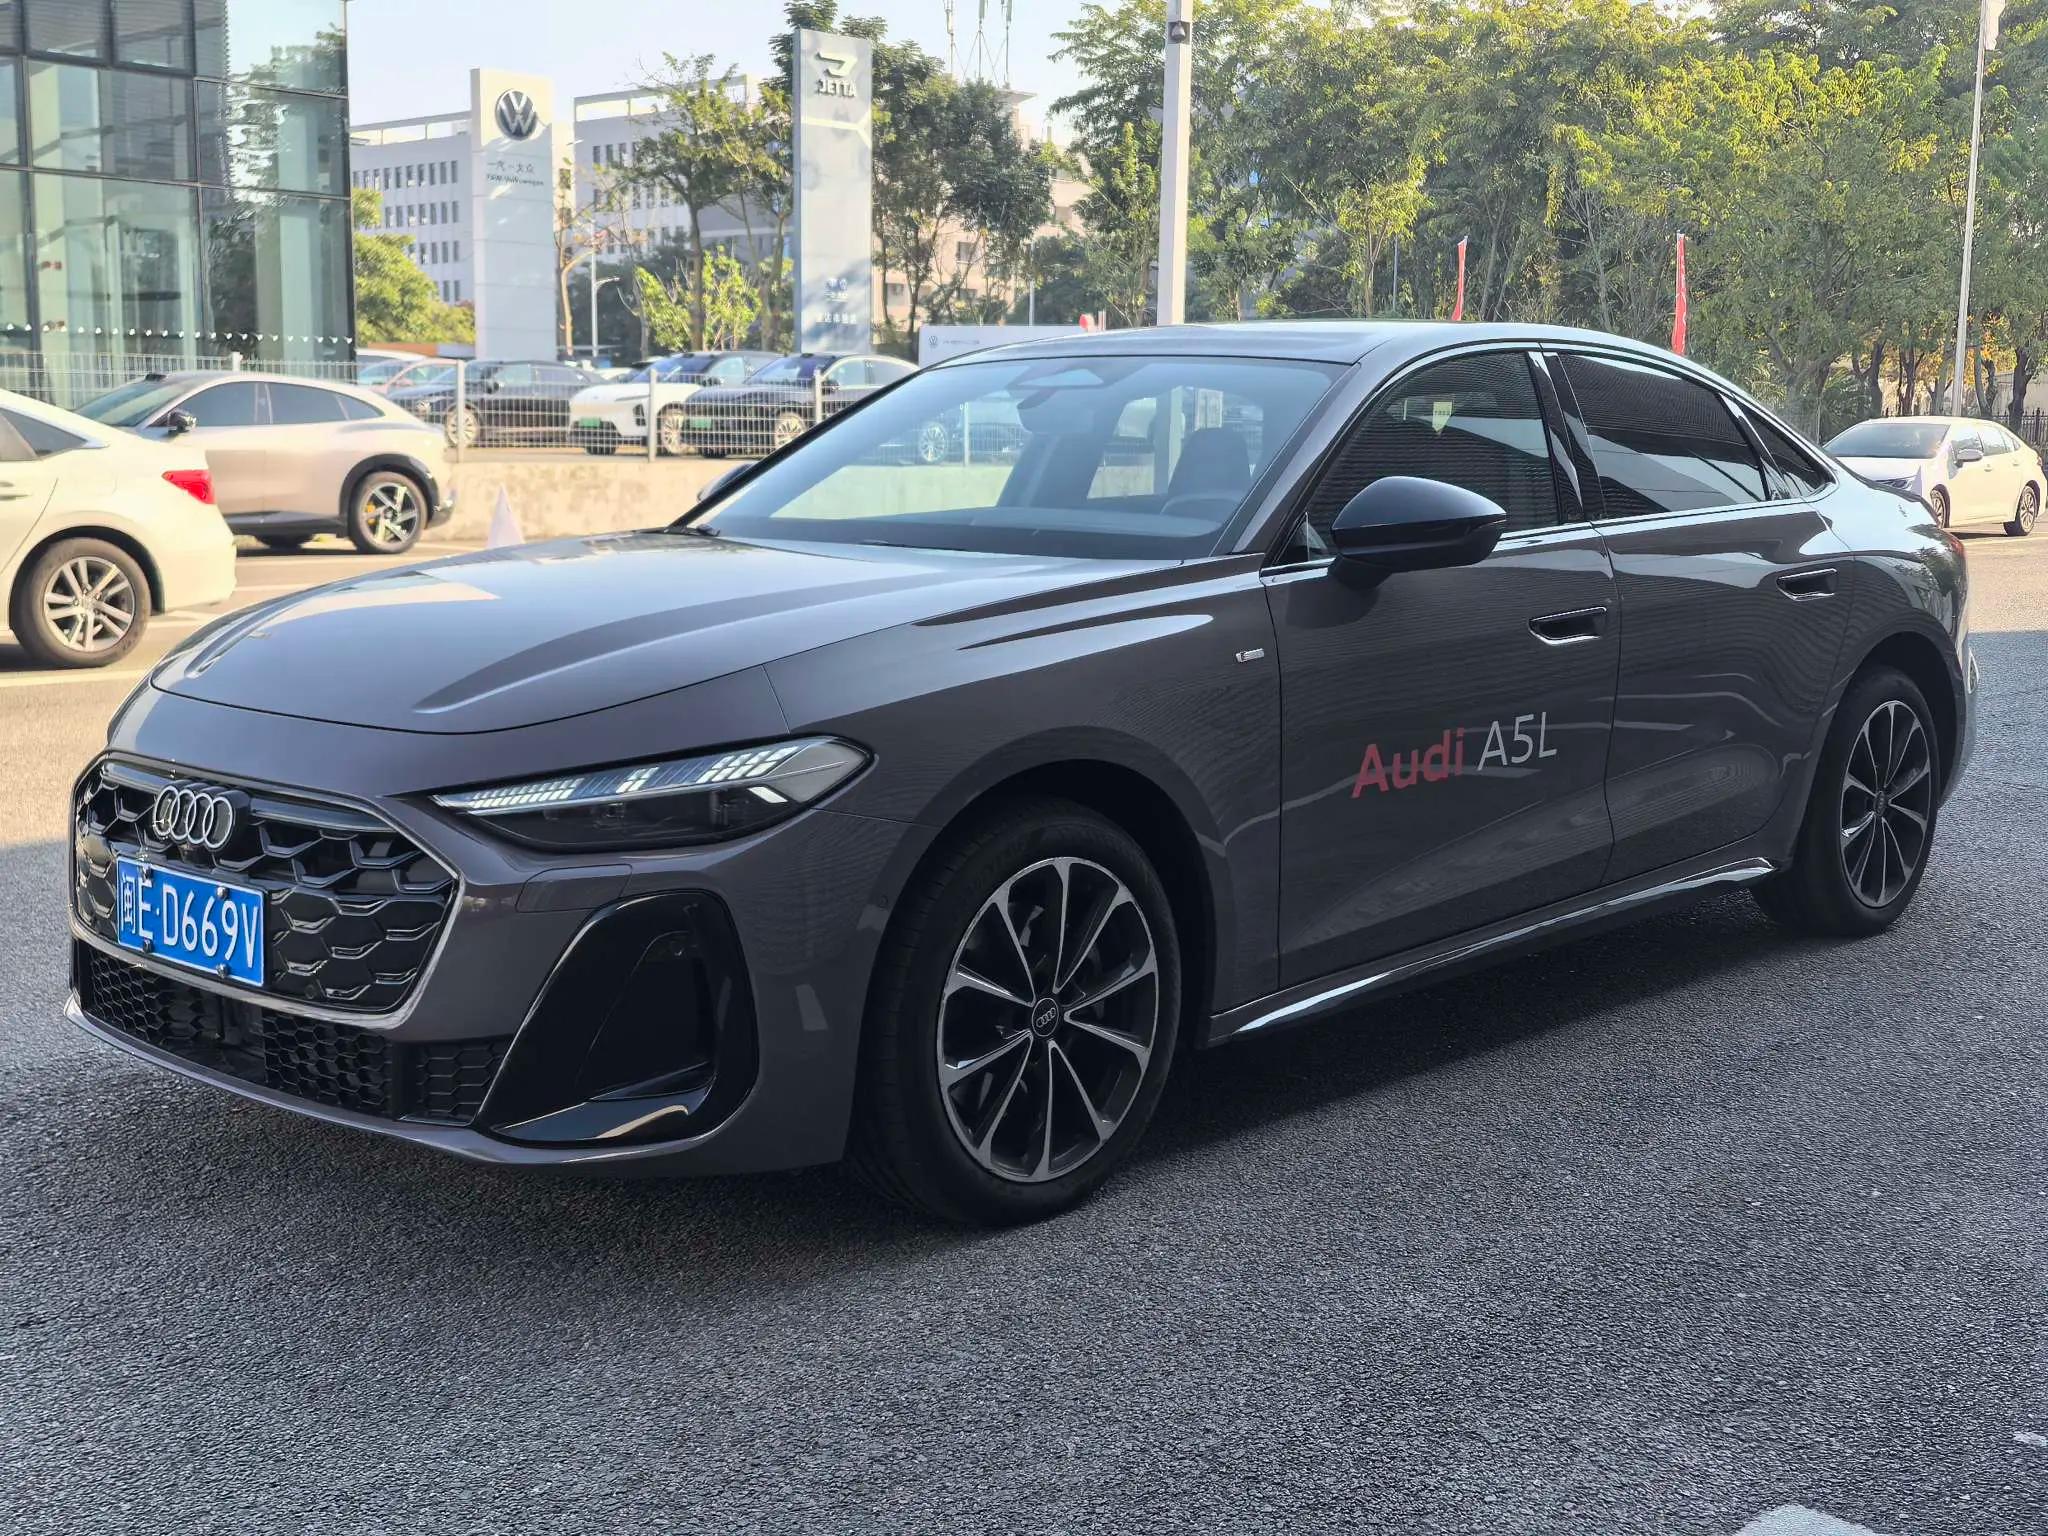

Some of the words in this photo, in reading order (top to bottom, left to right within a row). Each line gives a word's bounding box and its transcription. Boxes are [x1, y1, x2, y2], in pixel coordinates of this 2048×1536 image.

[818, 79, 857, 97] JETTA
[1352, 727, 1465, 798] Audi
[1477, 711, 1557, 771] A5L
